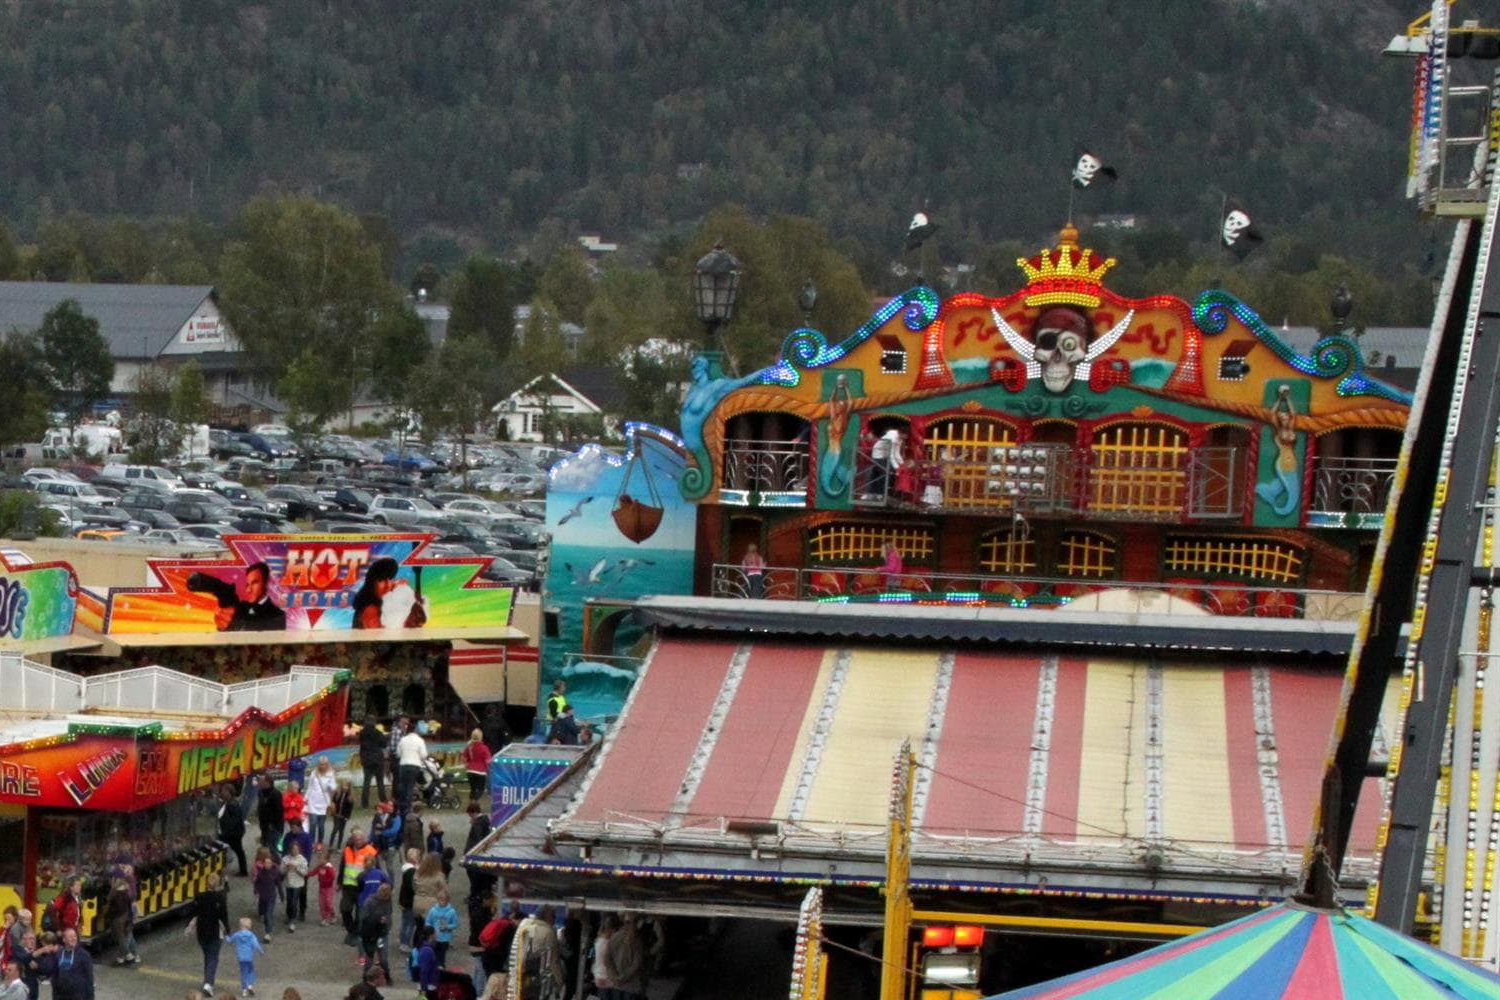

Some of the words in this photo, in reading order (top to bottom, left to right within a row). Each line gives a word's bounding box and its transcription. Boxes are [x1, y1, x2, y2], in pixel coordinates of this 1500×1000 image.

[279, 548, 371, 588] HOT
[279, 591, 351, 607] SHOTS
[178, 737, 247, 794] MEGA
[252, 712, 315, 770] STORE
